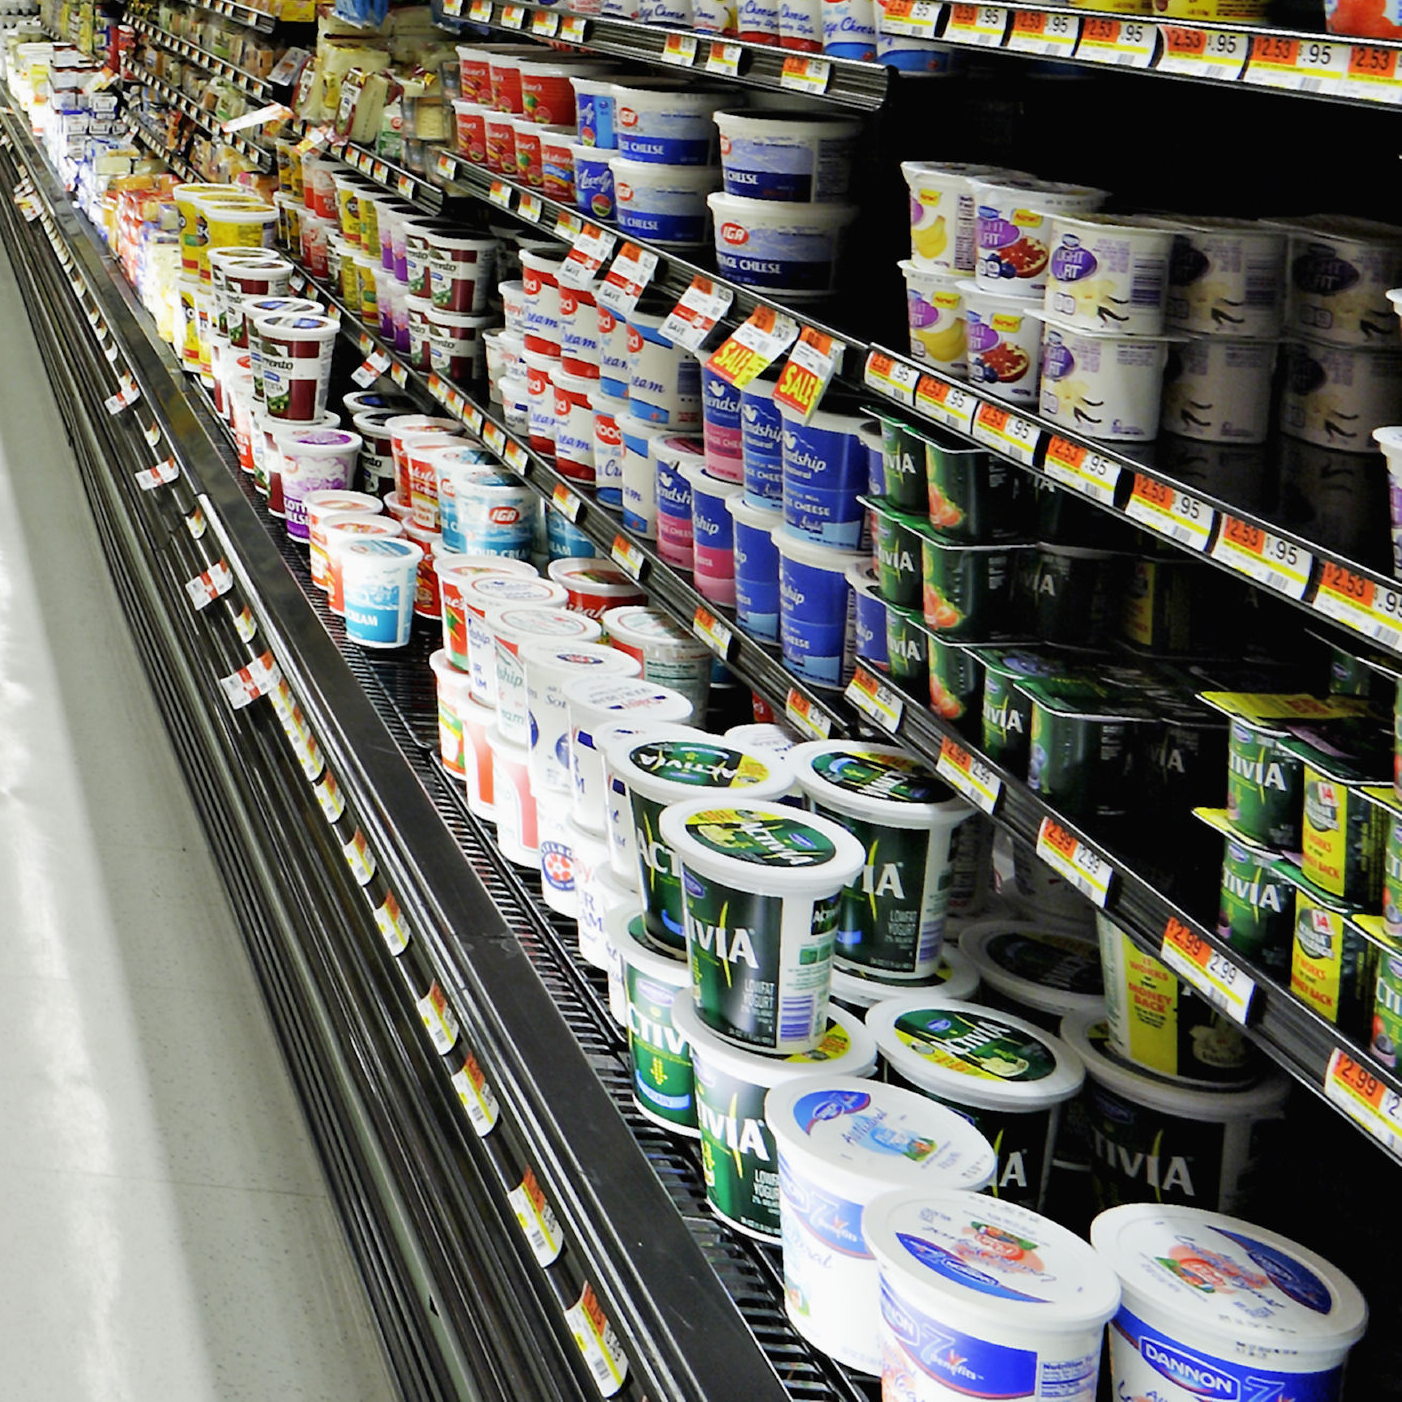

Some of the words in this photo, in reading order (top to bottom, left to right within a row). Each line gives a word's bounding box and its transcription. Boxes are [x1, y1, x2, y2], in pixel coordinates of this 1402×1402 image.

[630, 142, 664, 156] CHEESE
[727, 171, 759, 186] CHEESE
[627, 218, 659, 231] CHEESE
[1015, 213, 1041, 225] New!
[724, 227, 747, 242] IGA
[1056, 248, 1085, 265] LIGHT
[740, 258, 781, 275] CHEESE
[713, 341, 746, 384] SALE
[780, 364, 815, 405] SALE
[491, 507, 518, 523] IGA
[796, 500, 831, 518] CHEESE
[930, 1021, 1012, 1058] ACTIVIA
[1145, 1344, 1233, 1394] DANNON
